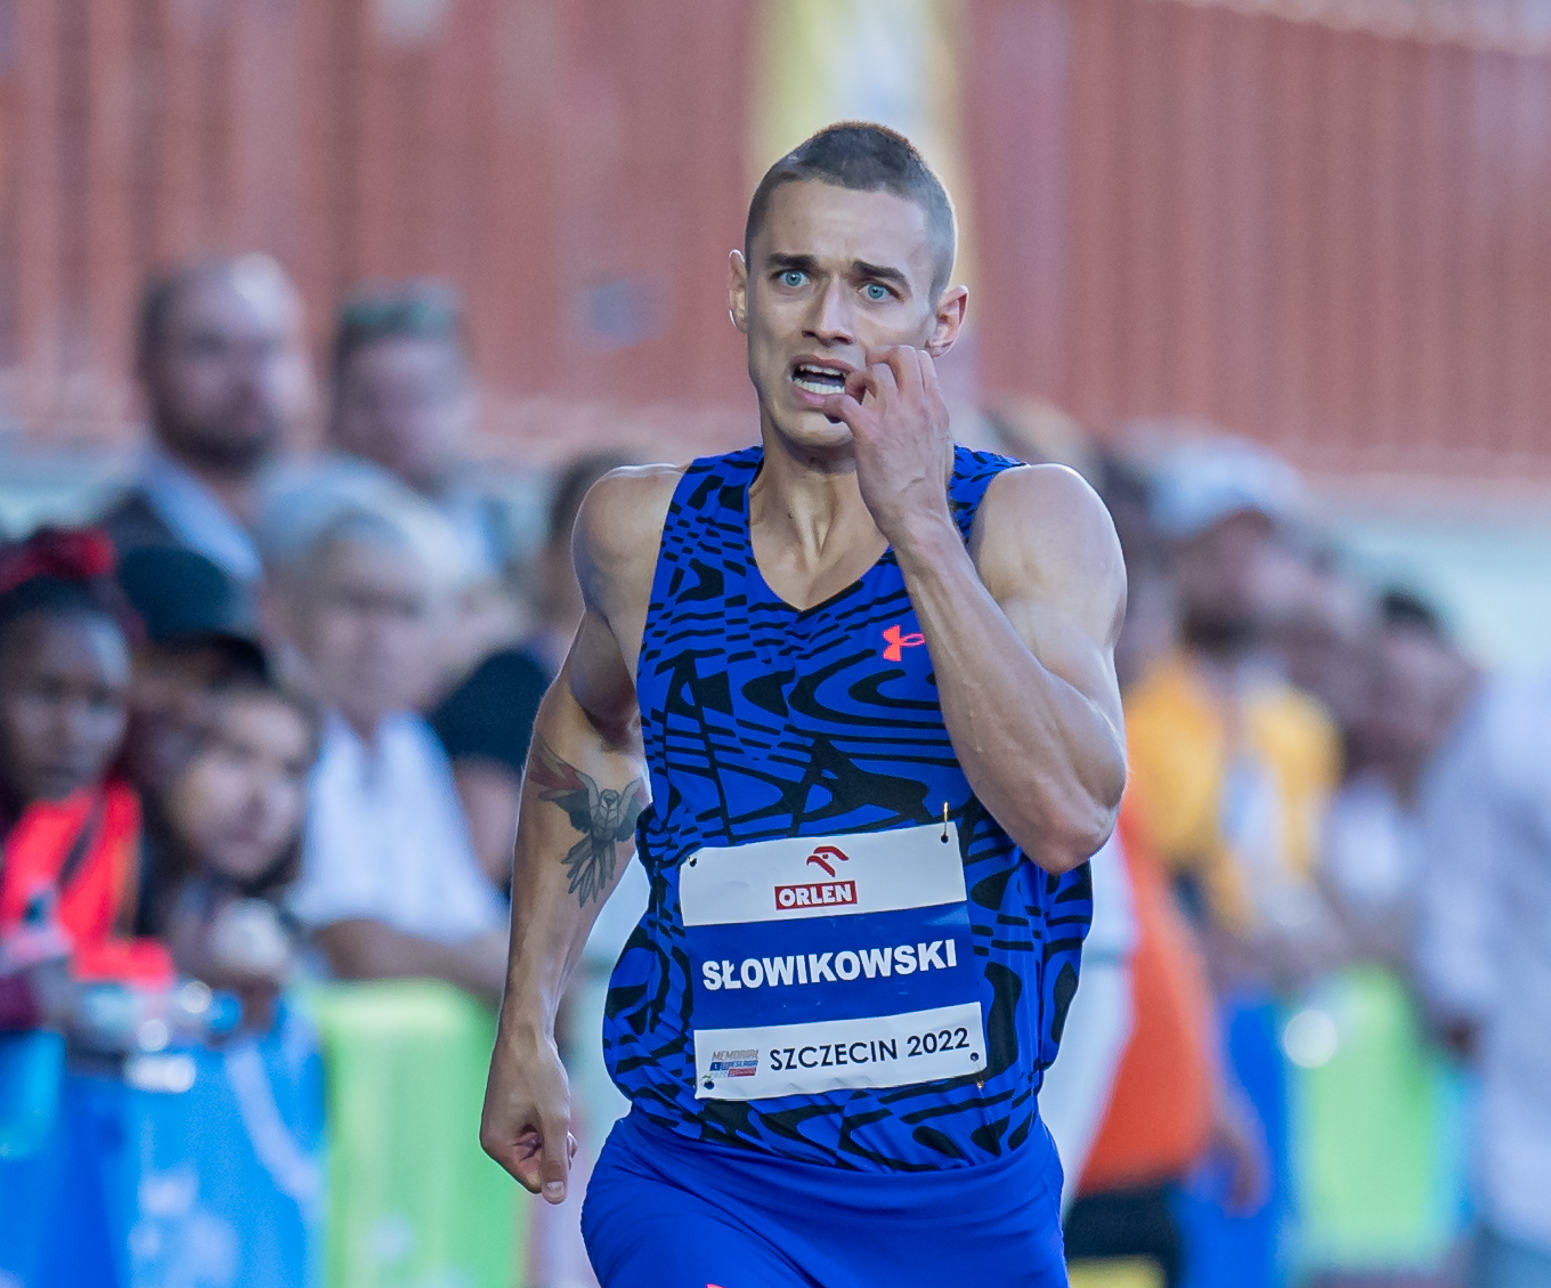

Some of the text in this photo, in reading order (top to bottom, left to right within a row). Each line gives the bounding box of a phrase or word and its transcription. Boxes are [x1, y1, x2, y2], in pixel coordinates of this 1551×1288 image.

[778, 883, 852, 907] ORLEN
[702, 939, 957, 990] SŁOWIKOWSKI
[770, 1027, 970, 1071] SZCZECIN 2022
